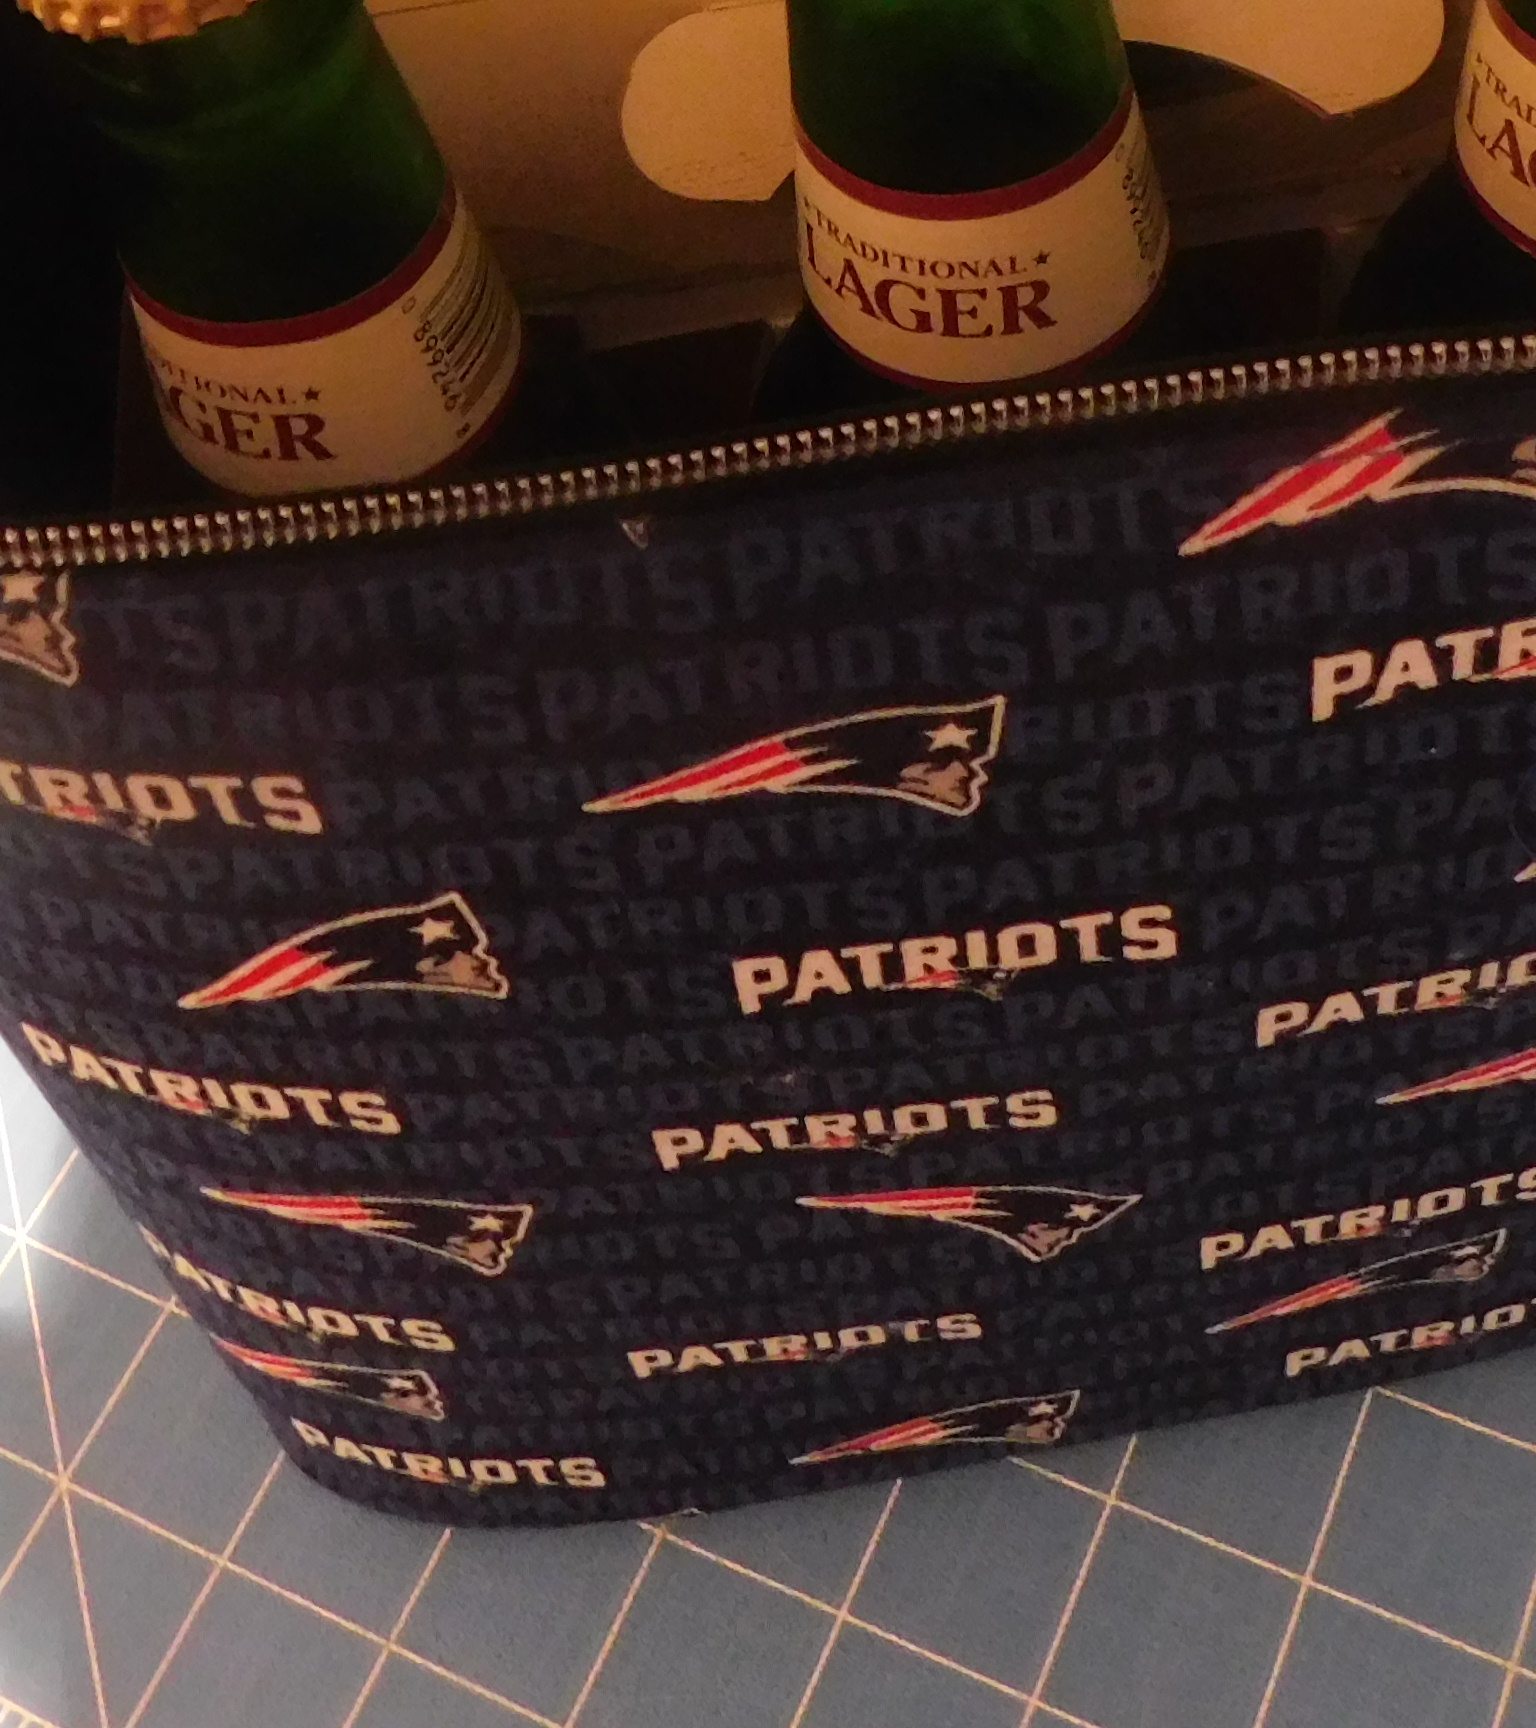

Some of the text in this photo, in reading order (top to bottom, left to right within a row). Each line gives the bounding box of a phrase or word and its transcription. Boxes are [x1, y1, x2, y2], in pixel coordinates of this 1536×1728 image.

[806, 222, 1058, 339] LAGER
[815, 209, 1028, 278] TRADITIONAL
[168, 384, 338, 463] GER
[730, 902, 1180, 1017] PATRIOTS
[20, 1020, 406, 1135] PATRIOTS
[651, 1088, 1060, 1171] PATRIOTS
[626, 1311, 985, 1379] PATRIOTS
[290, 1416, 609, 1490] PATRIOTS
